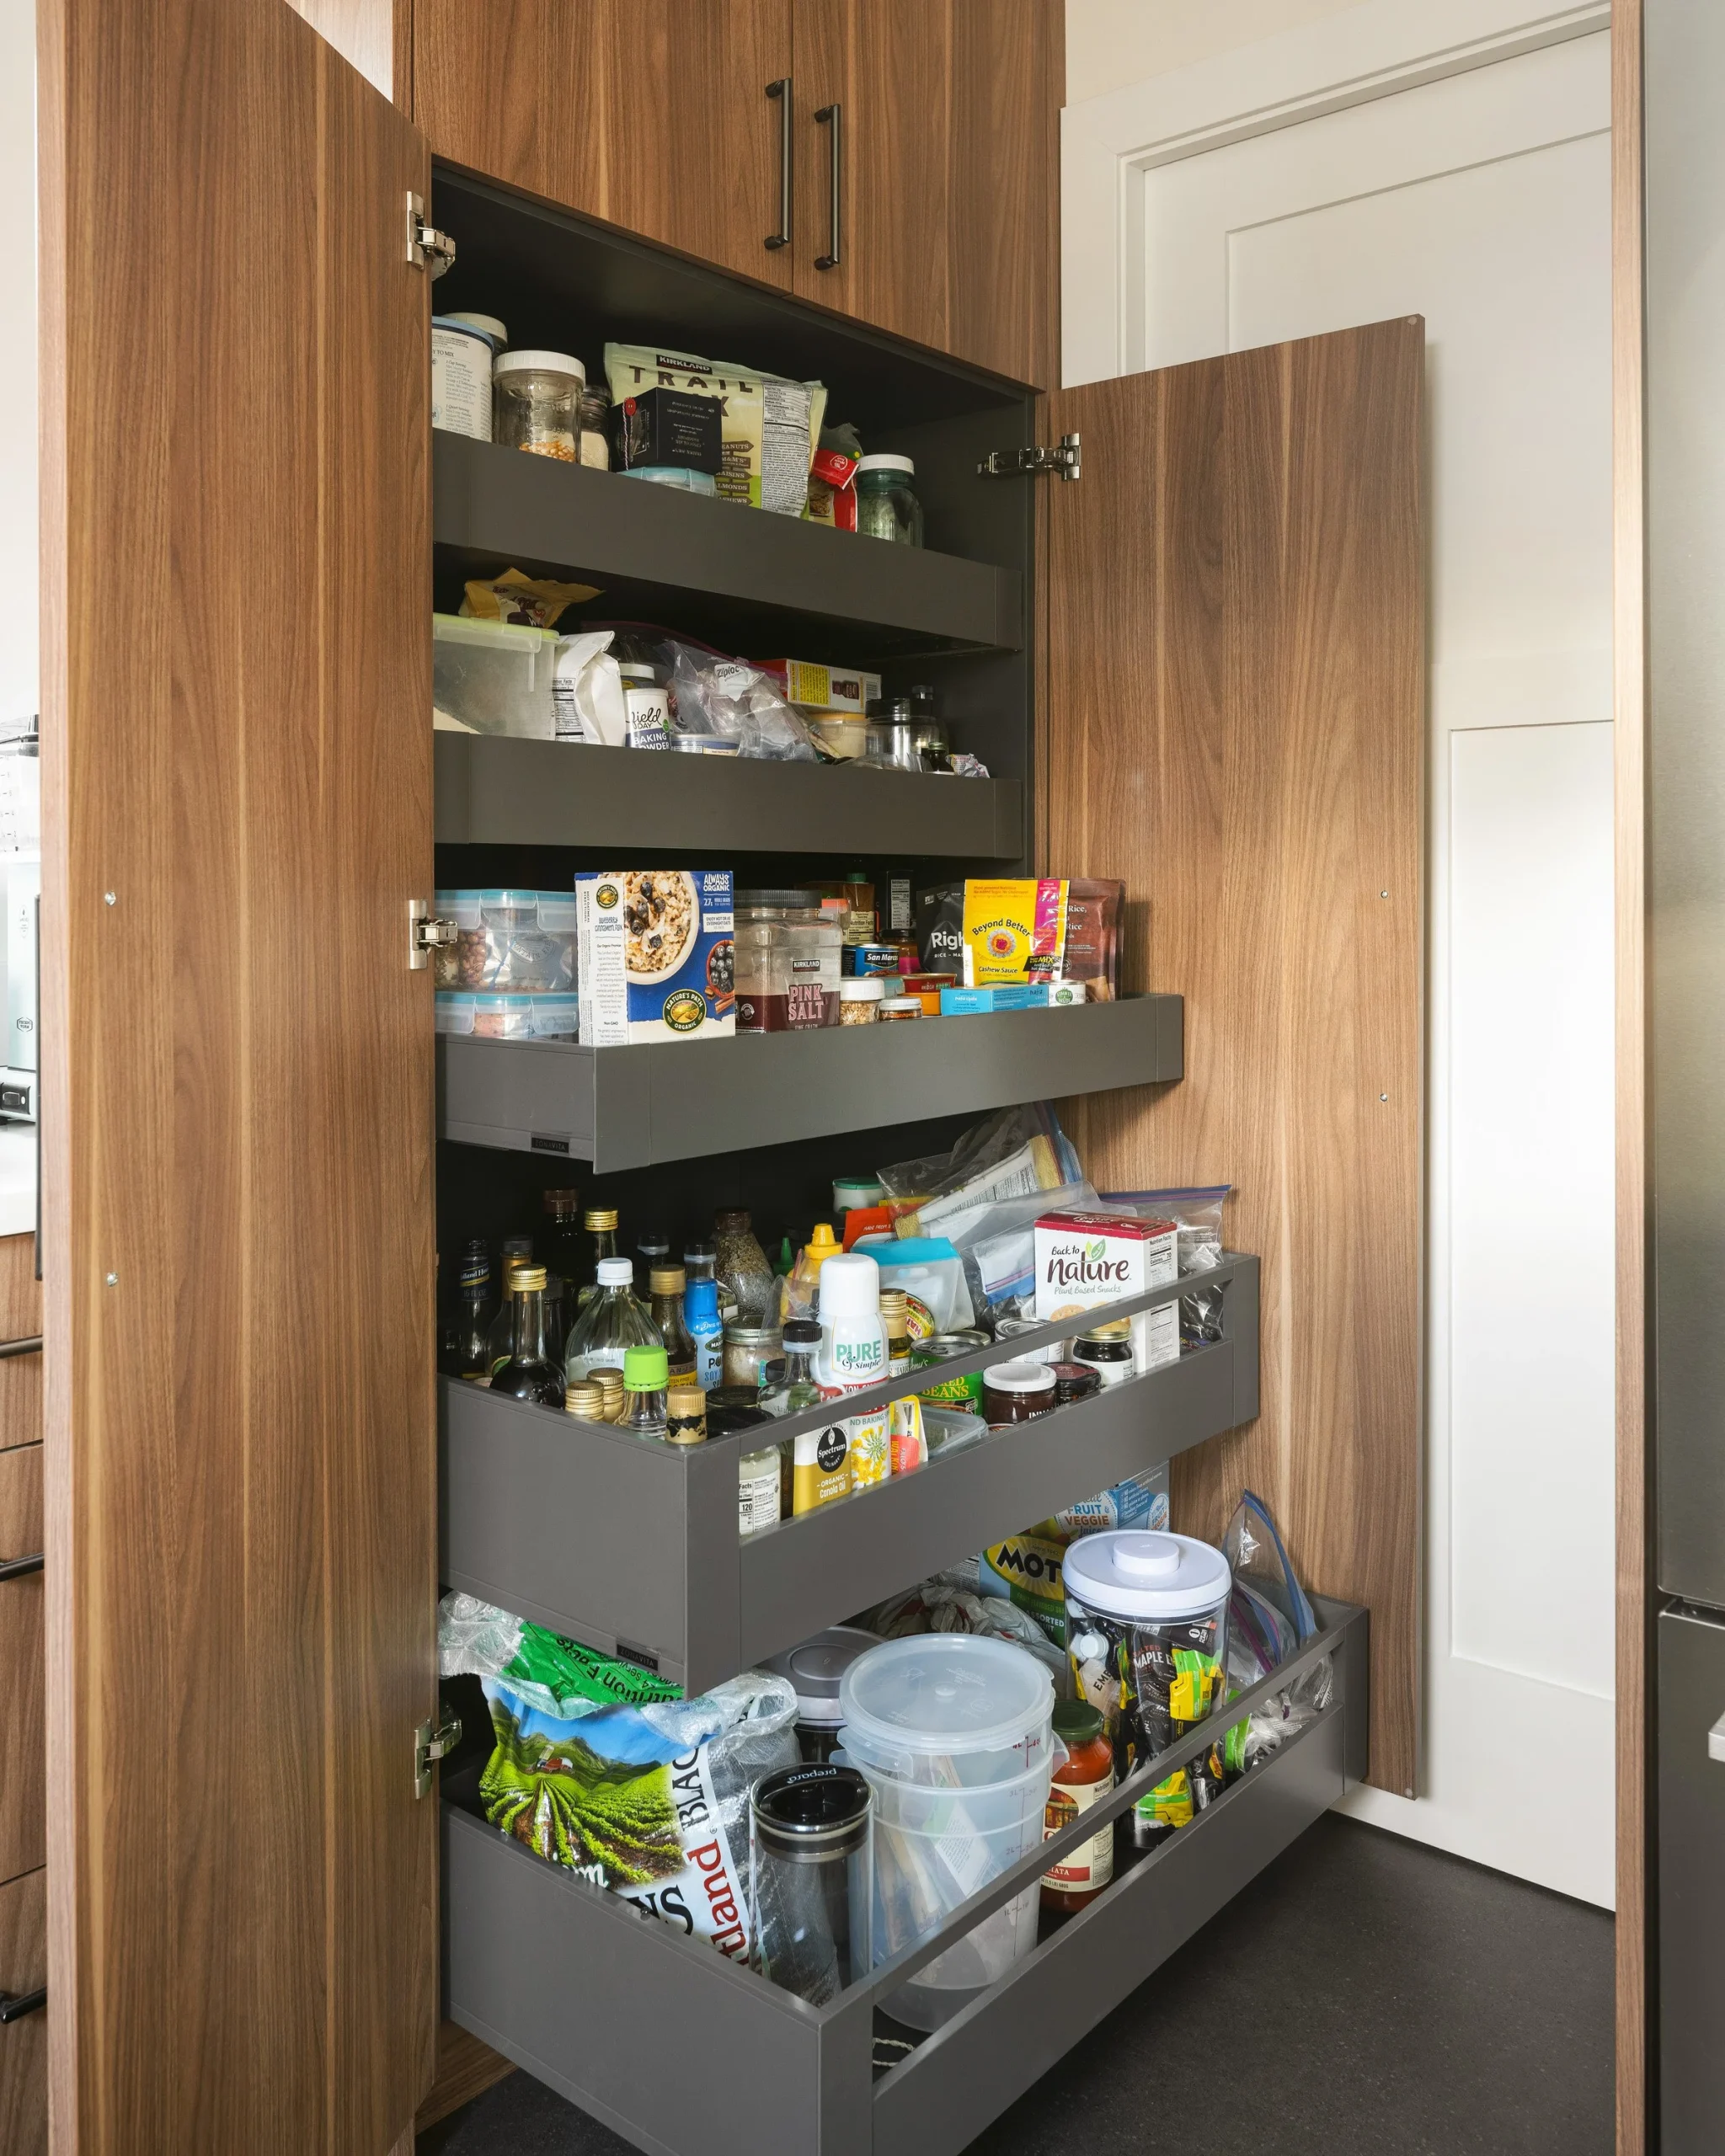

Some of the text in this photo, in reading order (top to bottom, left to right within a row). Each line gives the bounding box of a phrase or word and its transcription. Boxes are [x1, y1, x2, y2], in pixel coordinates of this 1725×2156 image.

[659, 355, 710, 371] KIRKLAND
[629, 365, 753, 393] TRAIL
[717, 664, 740, 678] Ziploc
[633, 732, 667, 745] BAKING
[638, 742, 670, 750] OWDER
[704, 873, 730, 885] ALWAYS
[1069, 905, 1087, 914] Rice,
[972, 918, 1031, 937] Beyond Better
[931, 931, 964, 950] Righ
[666, 992, 703, 1010] NATURE'S PATH
[789, 984, 822, 1002] PINK
[788, 1001, 824, 1021] SALT
[674, 1022, 697, 1030] ORGANIC
[1051, 1245, 1080, 1256] Back to
[1047, 1251, 1130, 1287] nature
[1054, 1283, 1122, 1295] Plant Based Snacks
[906, 1316, 922, 1336] HAT
[836, 1339, 882, 1363] PURE
[670, 1365, 688, 1374] AN-J
[855, 1358, 881, 1370] Simple
[862, 1415, 884, 1426] BAKING
[818, 1443, 846, 1460] Spectrum
[891, 1440, 900, 1474] WALKIN
[820, 1473, 845, 1488] ORGANIC
[820, 1481, 846, 1499] Canola Oil
[742, 1502, 753, 1512] 120
[1067, 1503, 1102, 1515] FRUIT
[1065, 1515, 1110, 1526] VEGGIE
[996, 1543, 1062, 1583] MOT
[556, 1638, 601, 1682] Facts
[620, 1647, 654, 1668] ZONAVITA
[1134, 1651, 1164, 1668] MAPLE
[786, 1767, 837, 1785] prepara
[671, 1748, 710, 1832] BLAC
[686, 1838, 750, 1966] tland
